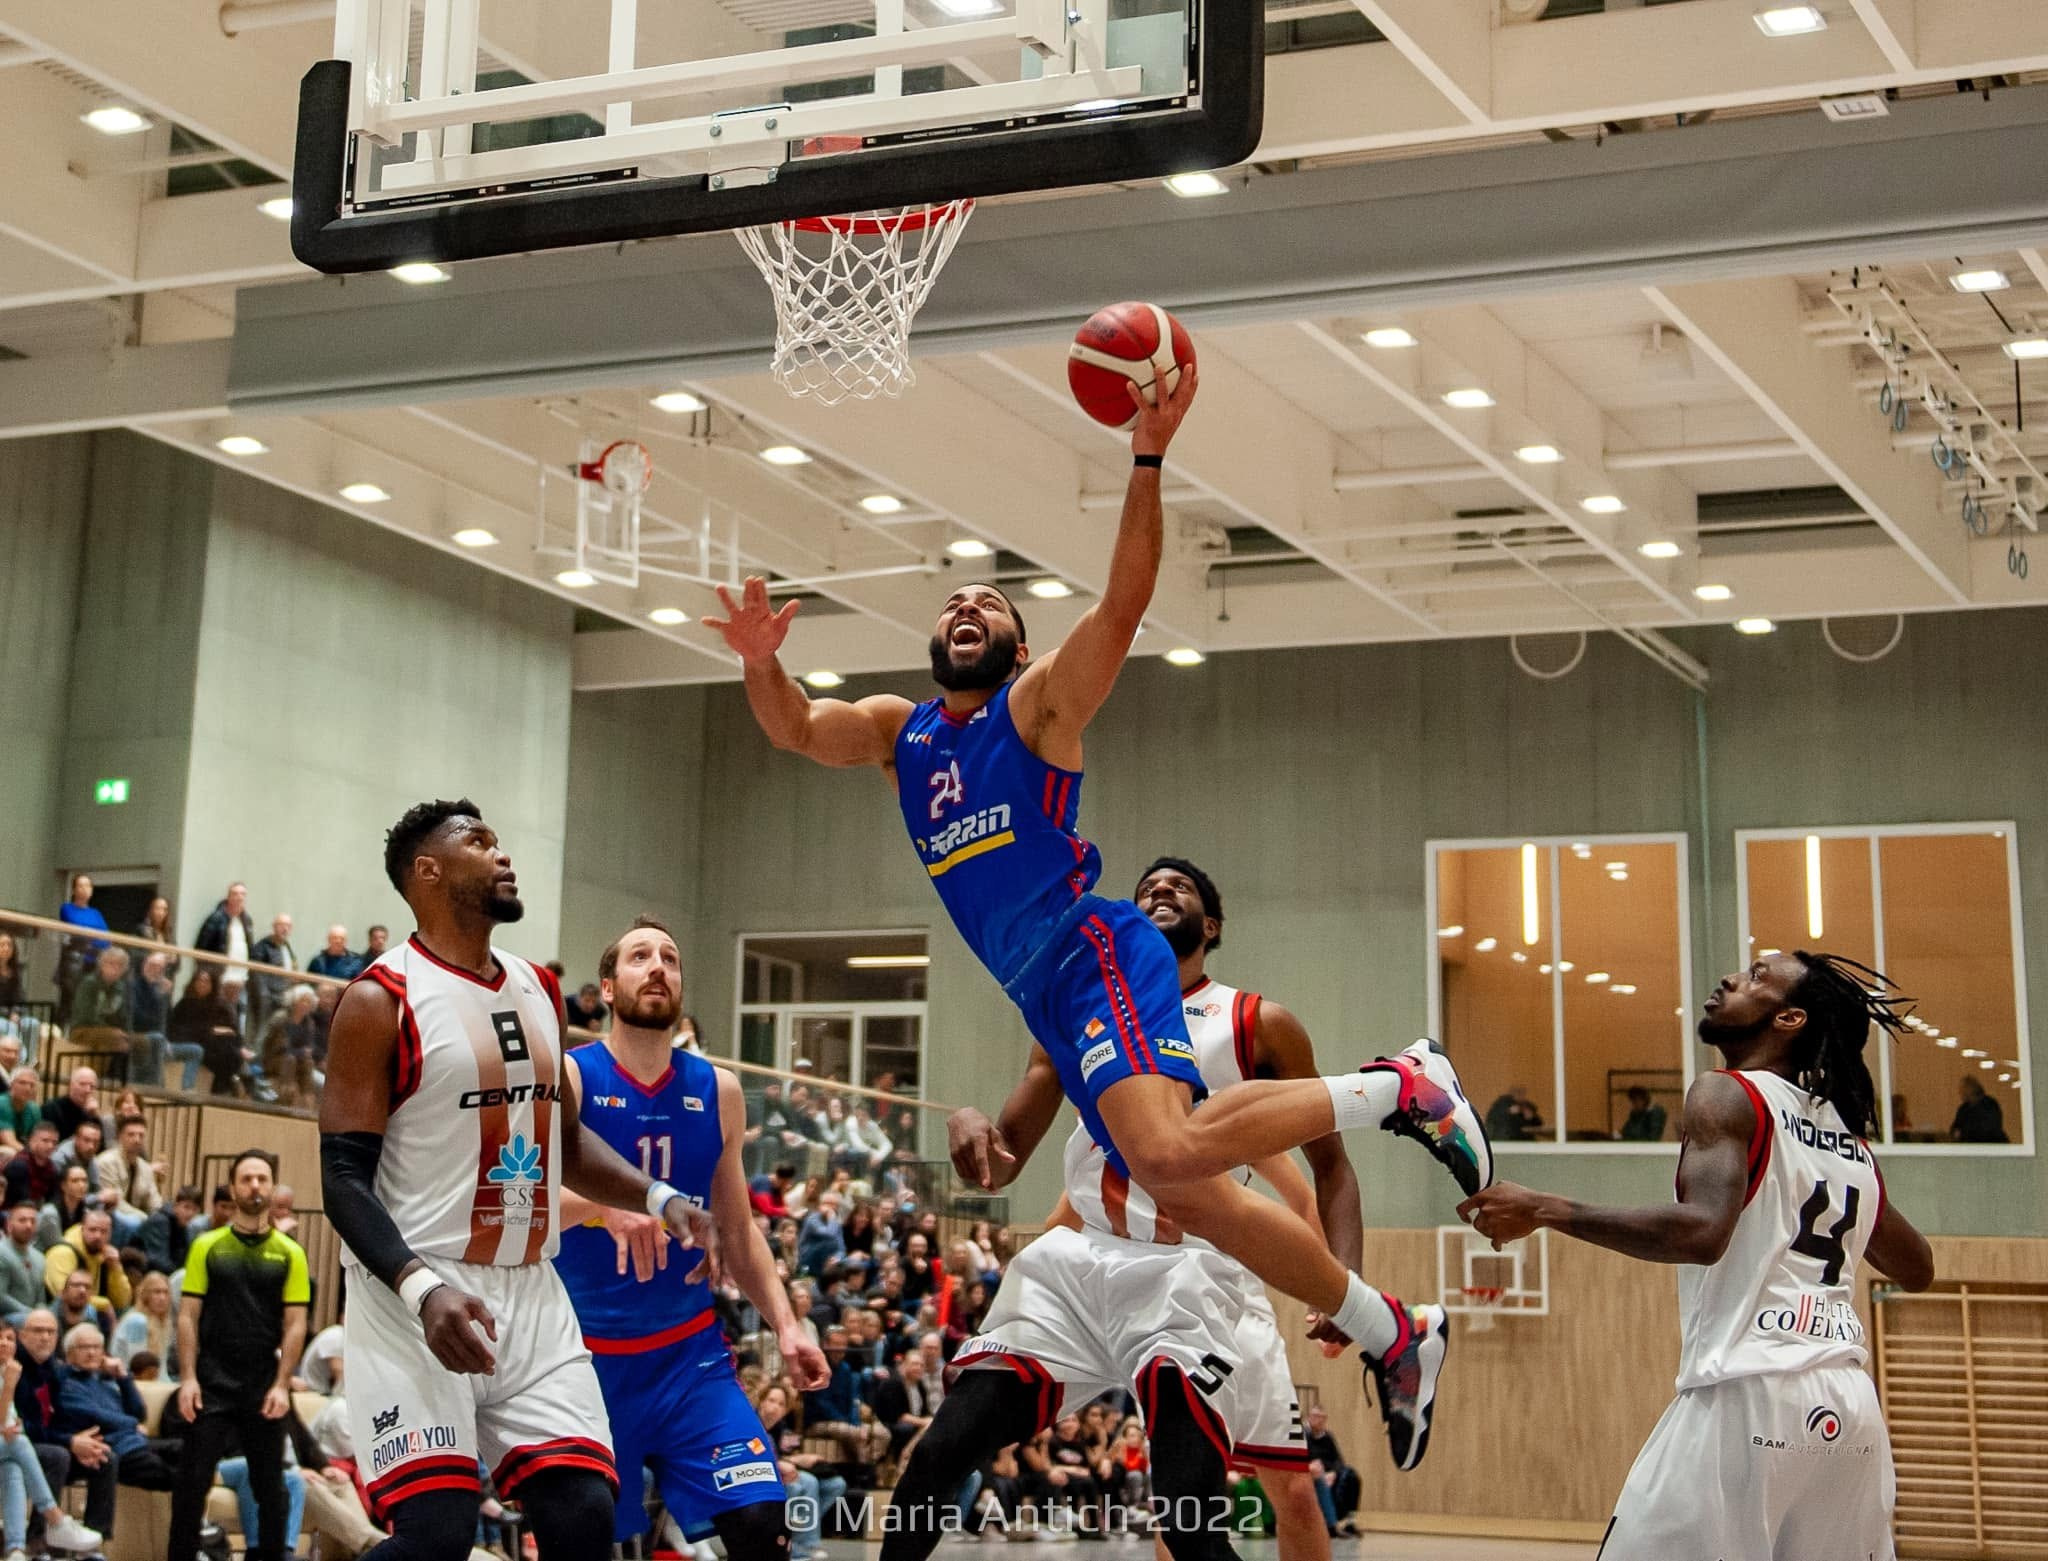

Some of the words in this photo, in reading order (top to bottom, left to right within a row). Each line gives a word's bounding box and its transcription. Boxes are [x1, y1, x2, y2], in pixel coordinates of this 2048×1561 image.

[929, 758, 963, 820] 24
[1185, 1006, 1208, 1018] SBL
[490, 1010, 530, 1062] 8
[459, 1083, 562, 1110] CENTRAL
[593, 1095, 627, 1109] NYON
[637, 1135, 672, 1180] 11
[500, 1187, 536, 1207] CSS
[1789, 1180, 1860, 1287] 4
